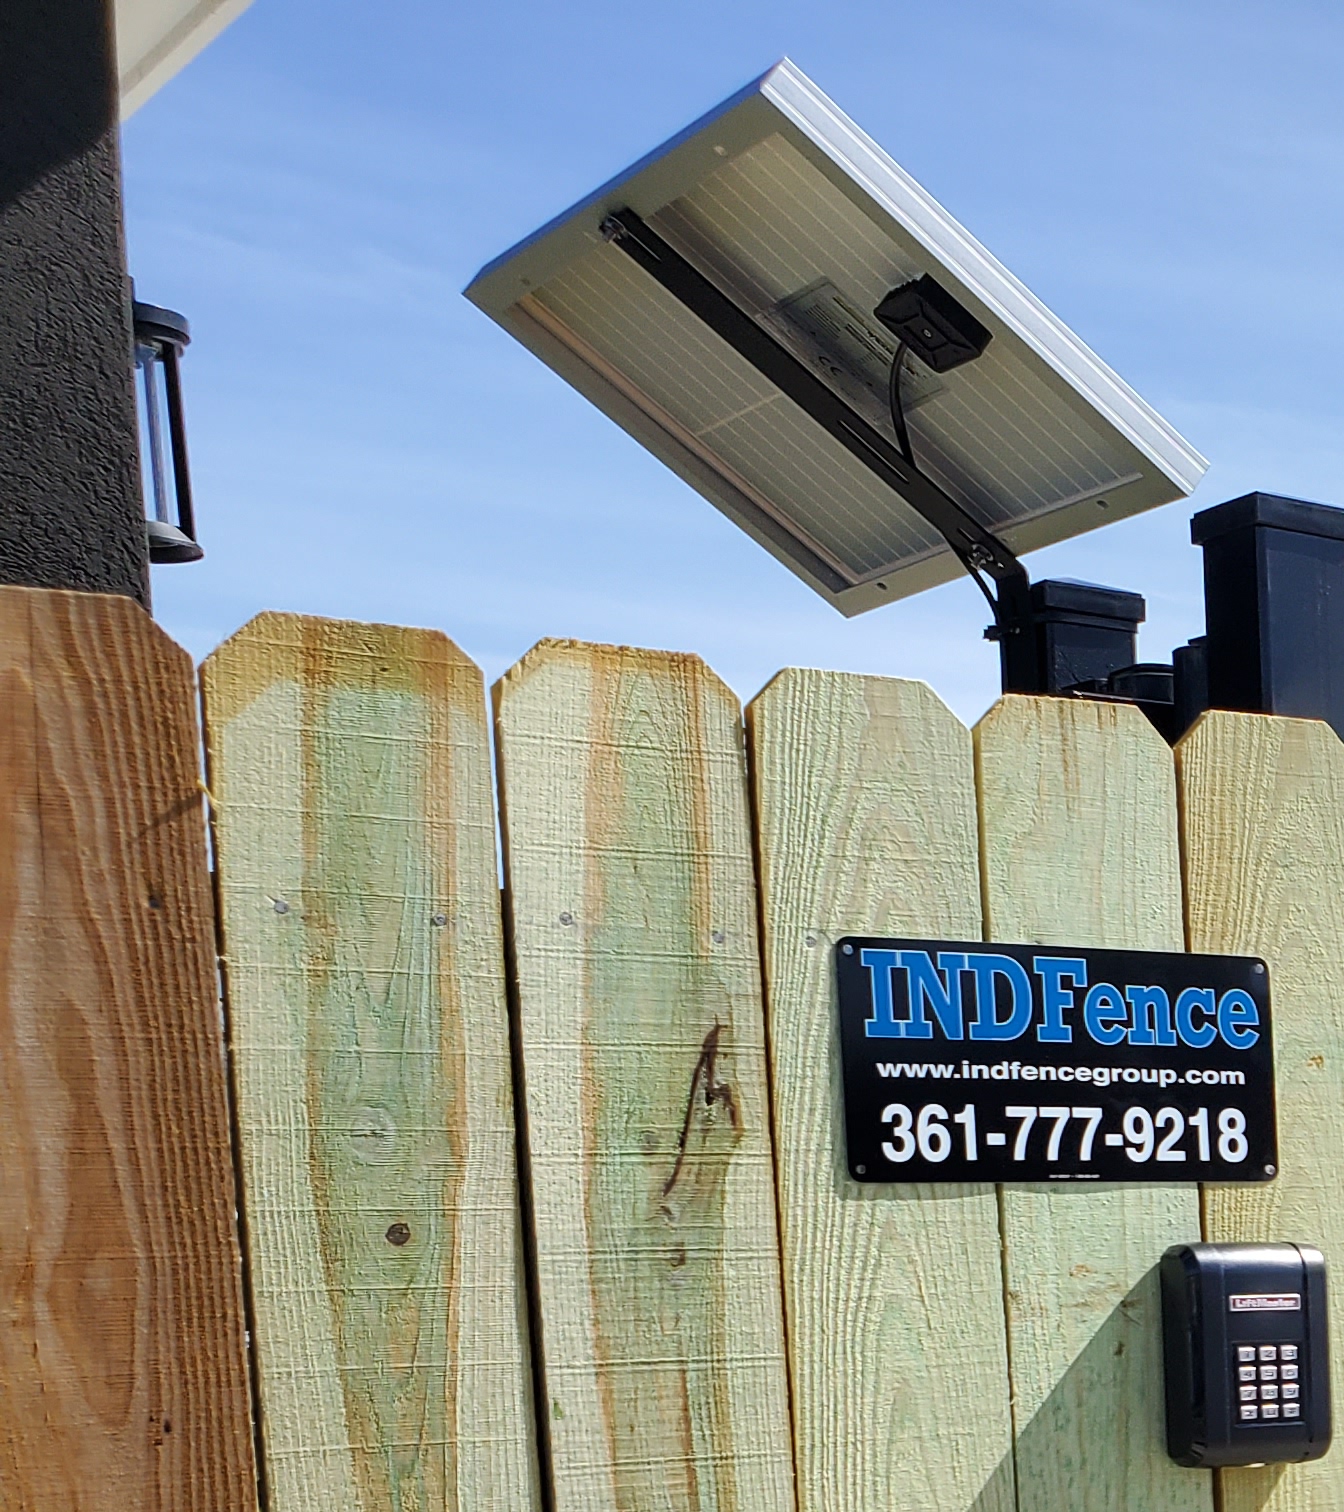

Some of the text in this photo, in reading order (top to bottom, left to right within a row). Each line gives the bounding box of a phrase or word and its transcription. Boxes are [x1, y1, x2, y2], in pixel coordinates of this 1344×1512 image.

[861, 949, 1260, 1050] INDFence
[876, 1060, 1245, 1088] www.indfencegroup.com
[881, 1103, 1249, 1163] 361-777-9218
